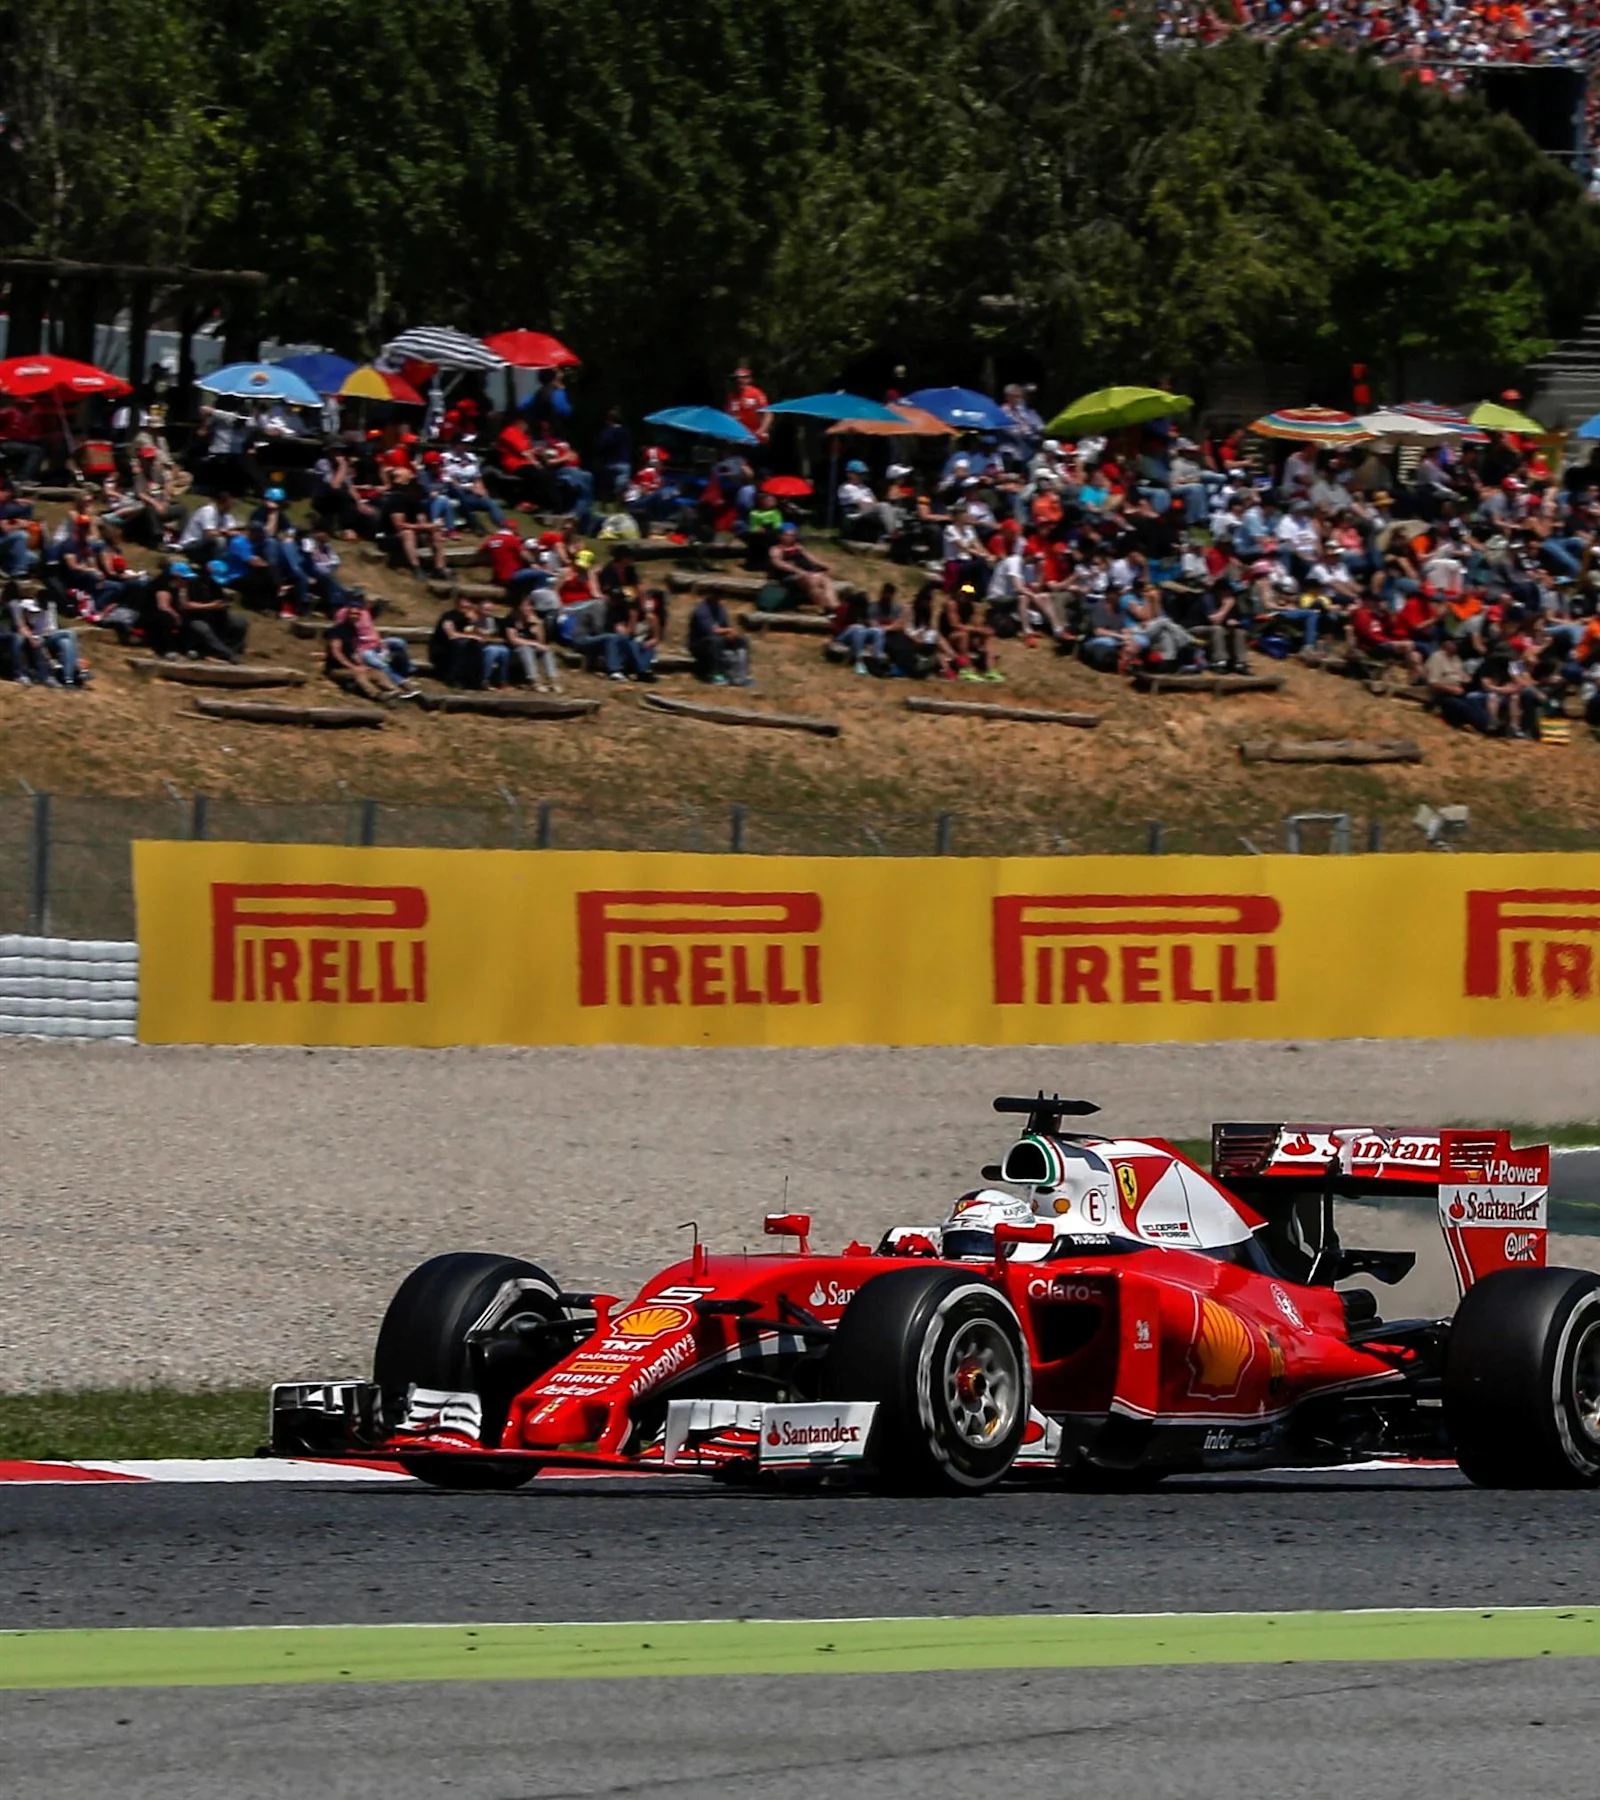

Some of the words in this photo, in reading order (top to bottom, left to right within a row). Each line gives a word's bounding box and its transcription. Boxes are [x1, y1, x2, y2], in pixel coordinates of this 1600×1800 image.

[211, 883, 428, 1003] PIRELLI
[577, 891, 822, 1006] PIRELLI
[992, 894, 1281, 1004] PIRELLI
[1484, 1159, 1542, 1184] V-Power
[1466, 1191, 1540, 1222] Santander
[646, 1286, 716, 1304] 5
[601, 1340, 653, 1351] TNT
[550, 1373, 620, 1385] MAHLE
[782, 1417, 861, 1446] Santander
[1203, 1428, 1234, 1450] infor
